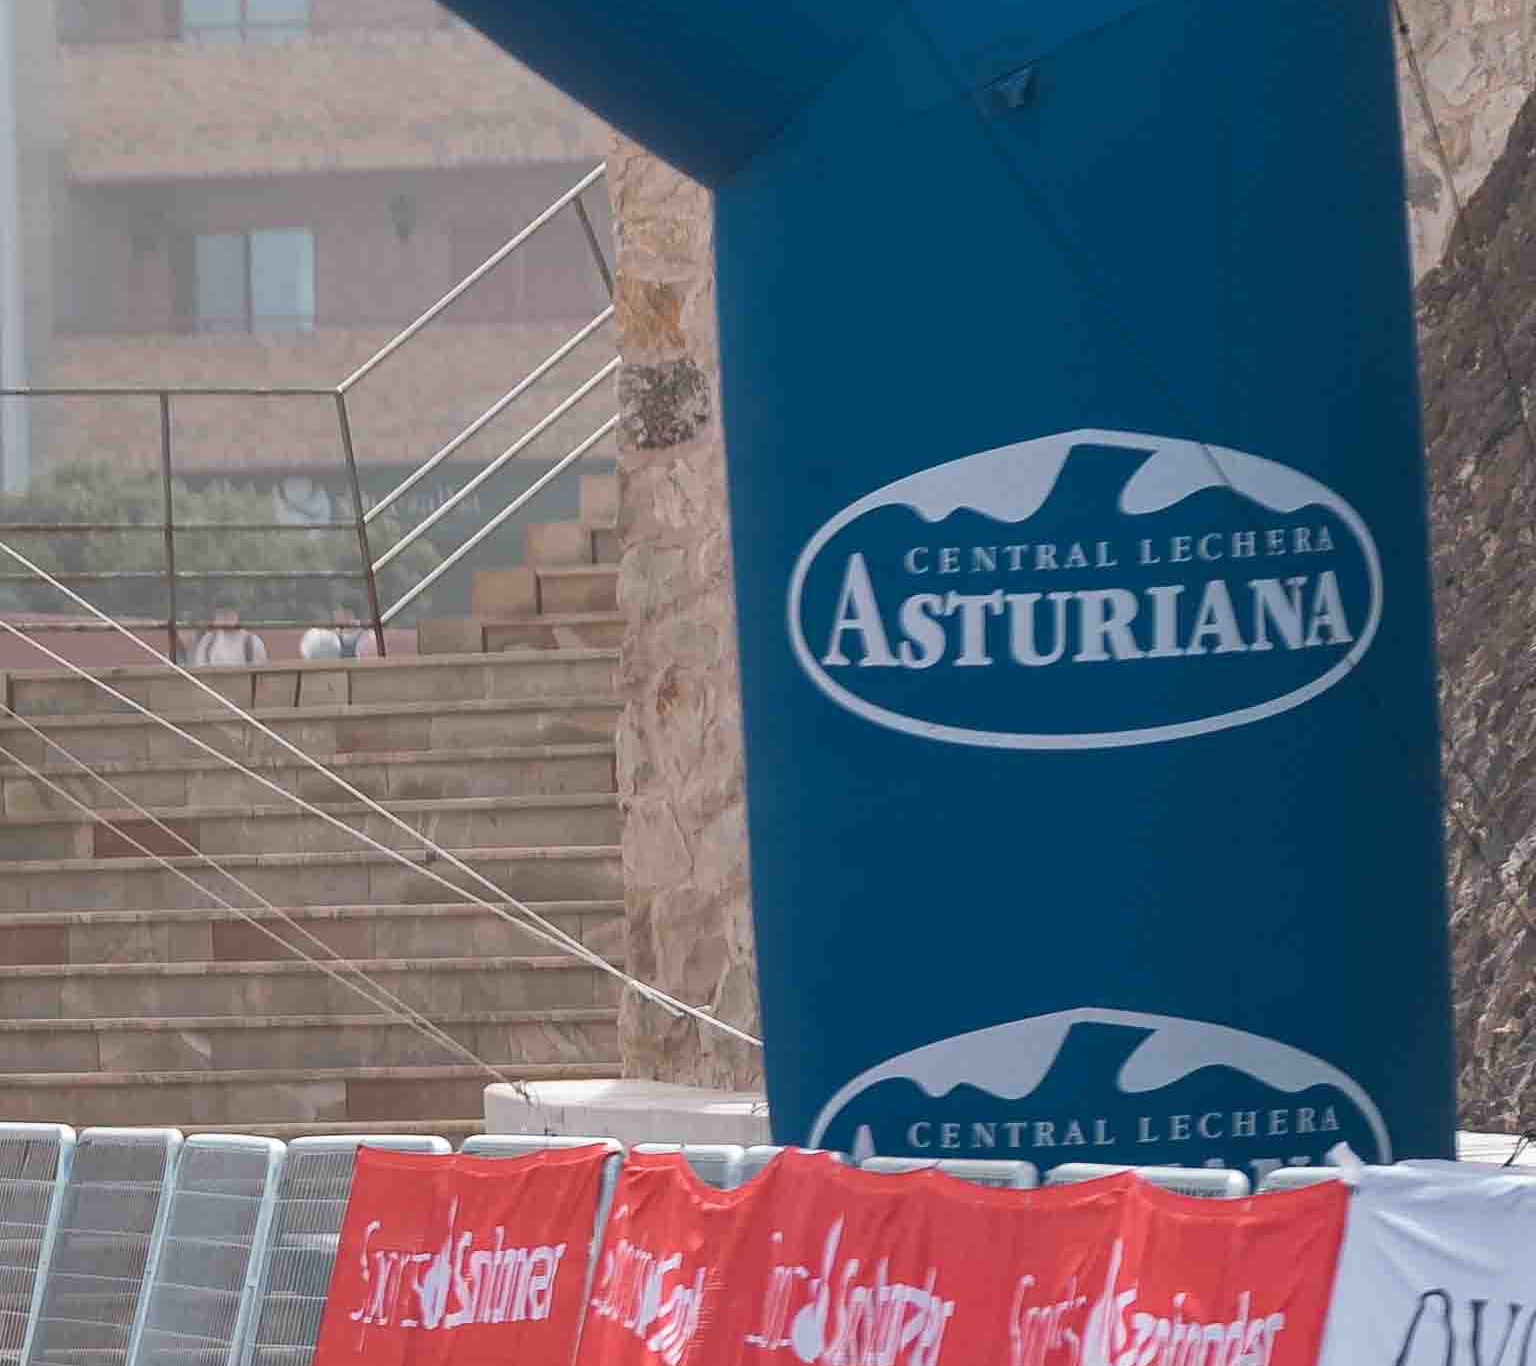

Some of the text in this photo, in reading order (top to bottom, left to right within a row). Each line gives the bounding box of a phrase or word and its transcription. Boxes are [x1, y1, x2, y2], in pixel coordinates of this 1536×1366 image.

[904, 522, 1336, 577] CENTRAL LECHERA
[823, 551, 1355, 669] ASTURIANA
[907, 1119, 1117, 1150] CENTRAL
[1136, 1106, 1341, 1143] LECHERA
